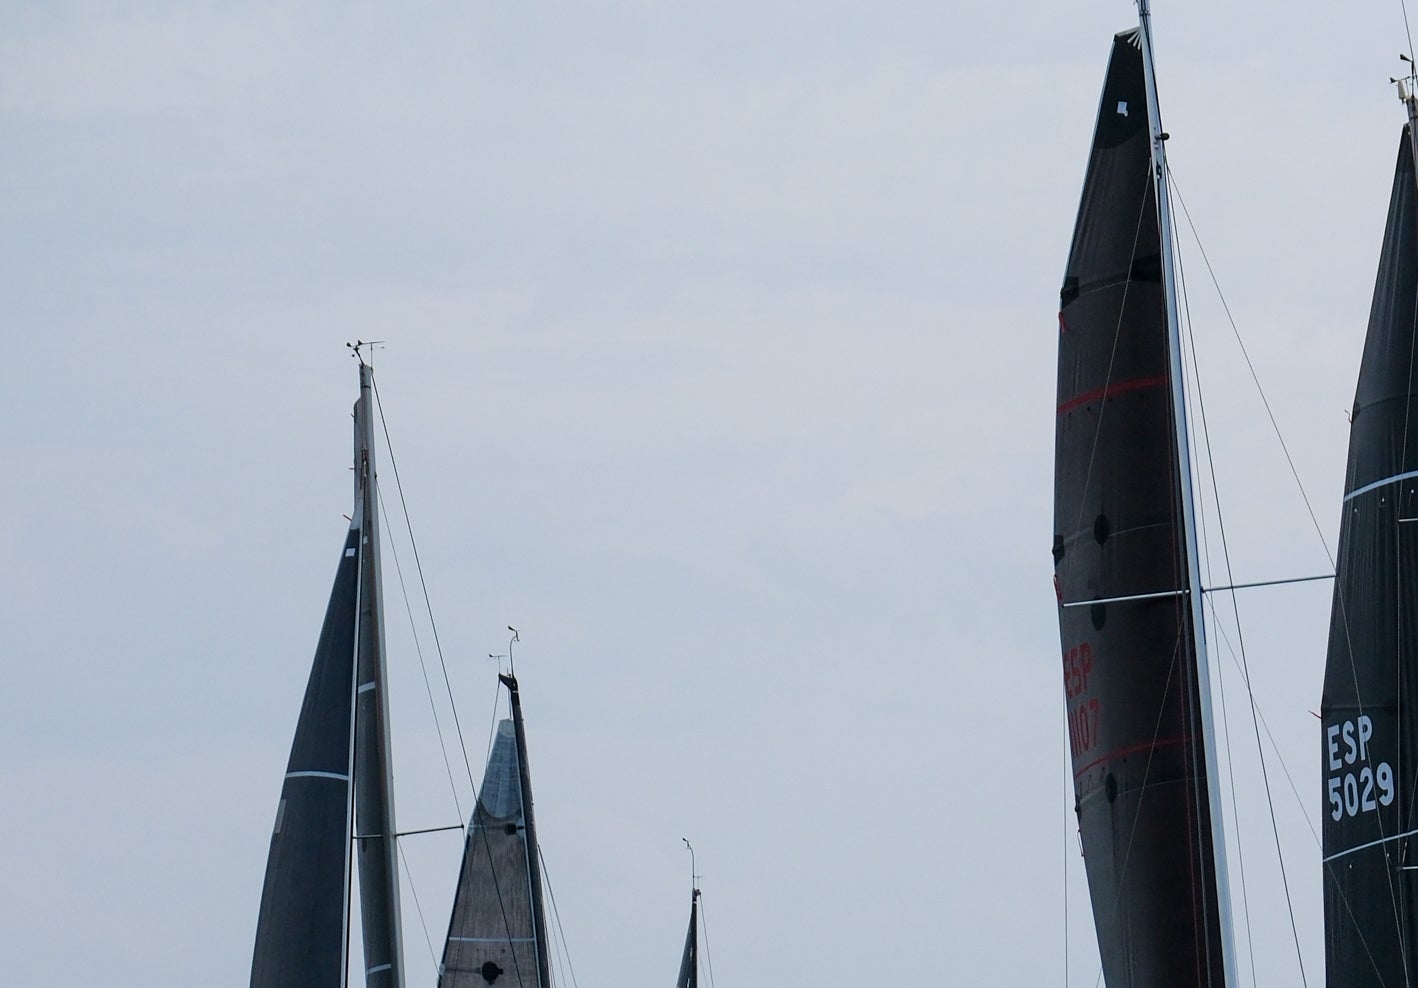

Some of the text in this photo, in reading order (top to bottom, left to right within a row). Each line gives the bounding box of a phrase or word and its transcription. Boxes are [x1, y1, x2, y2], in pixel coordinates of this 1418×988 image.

[1062, 642, 1092, 698] ESP
[1327, 715, 1373, 771] ESP
[1327, 762, 1394, 821] 5029
